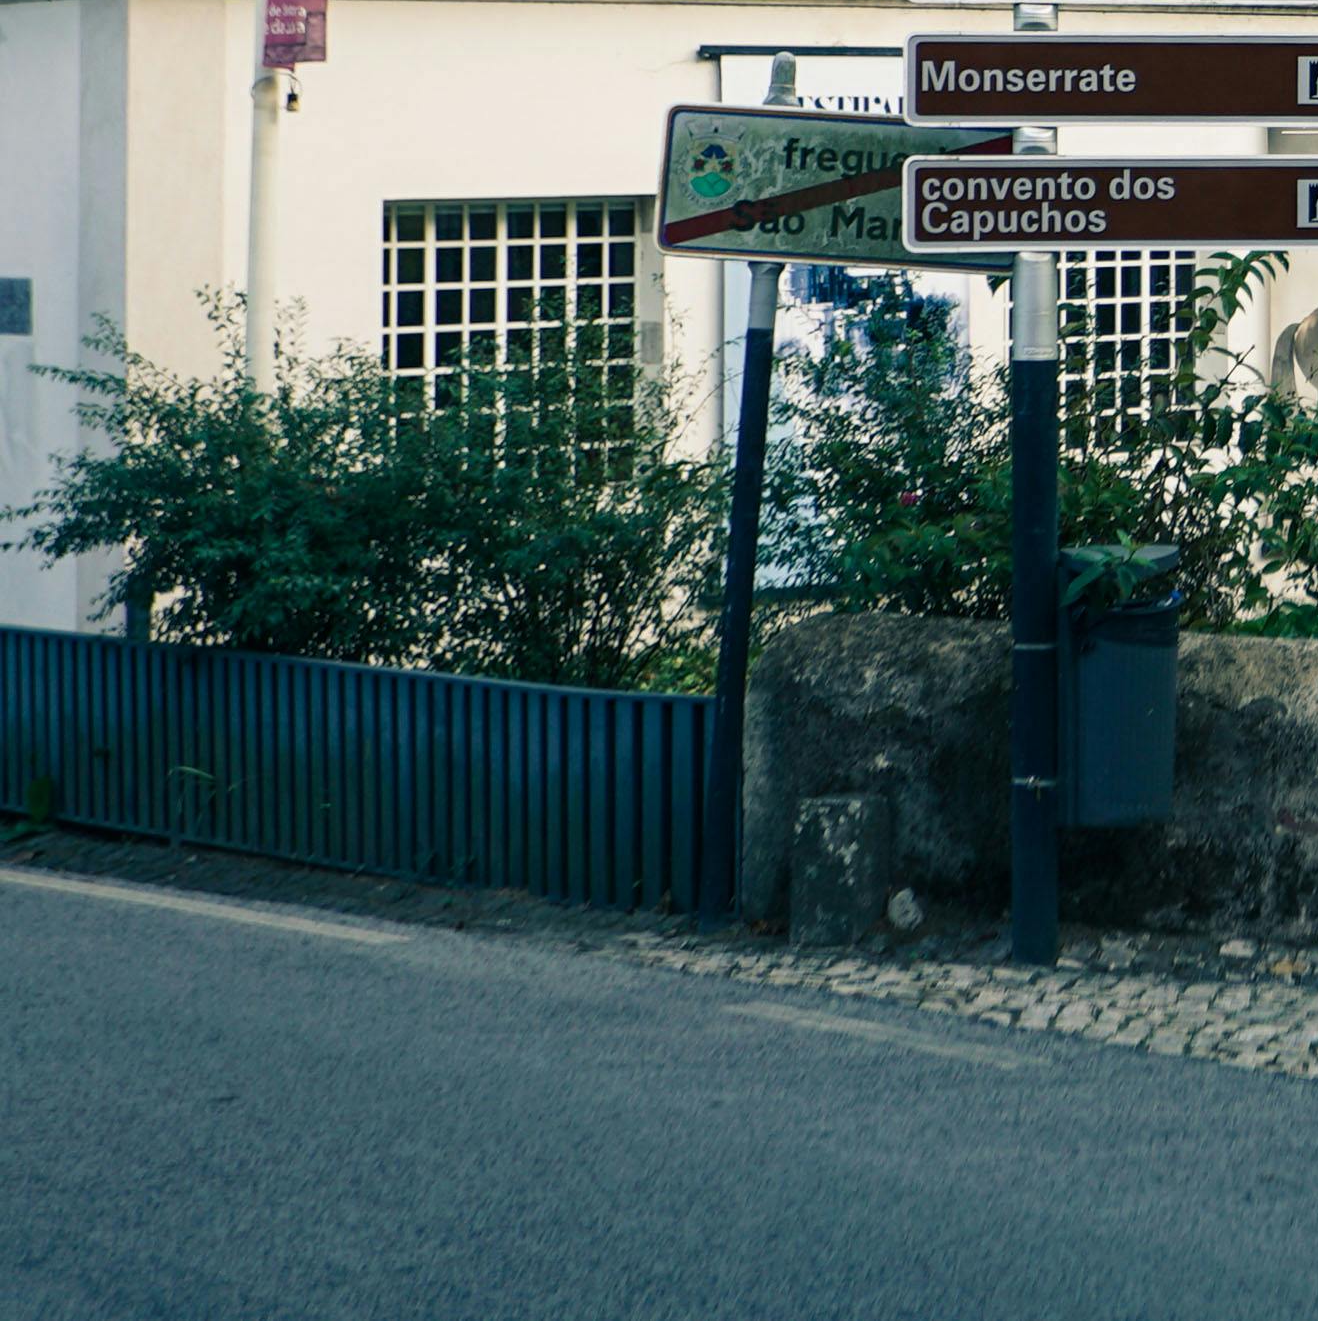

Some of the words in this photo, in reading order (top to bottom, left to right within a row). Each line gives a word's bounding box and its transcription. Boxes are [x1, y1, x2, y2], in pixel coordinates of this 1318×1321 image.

[921, 60, 1137, 93] Monserrate
[921, 171, 1097, 201] convento
[1108, 169, 1176, 200] dos
[921, 192, 1108, 241] Capuchos
